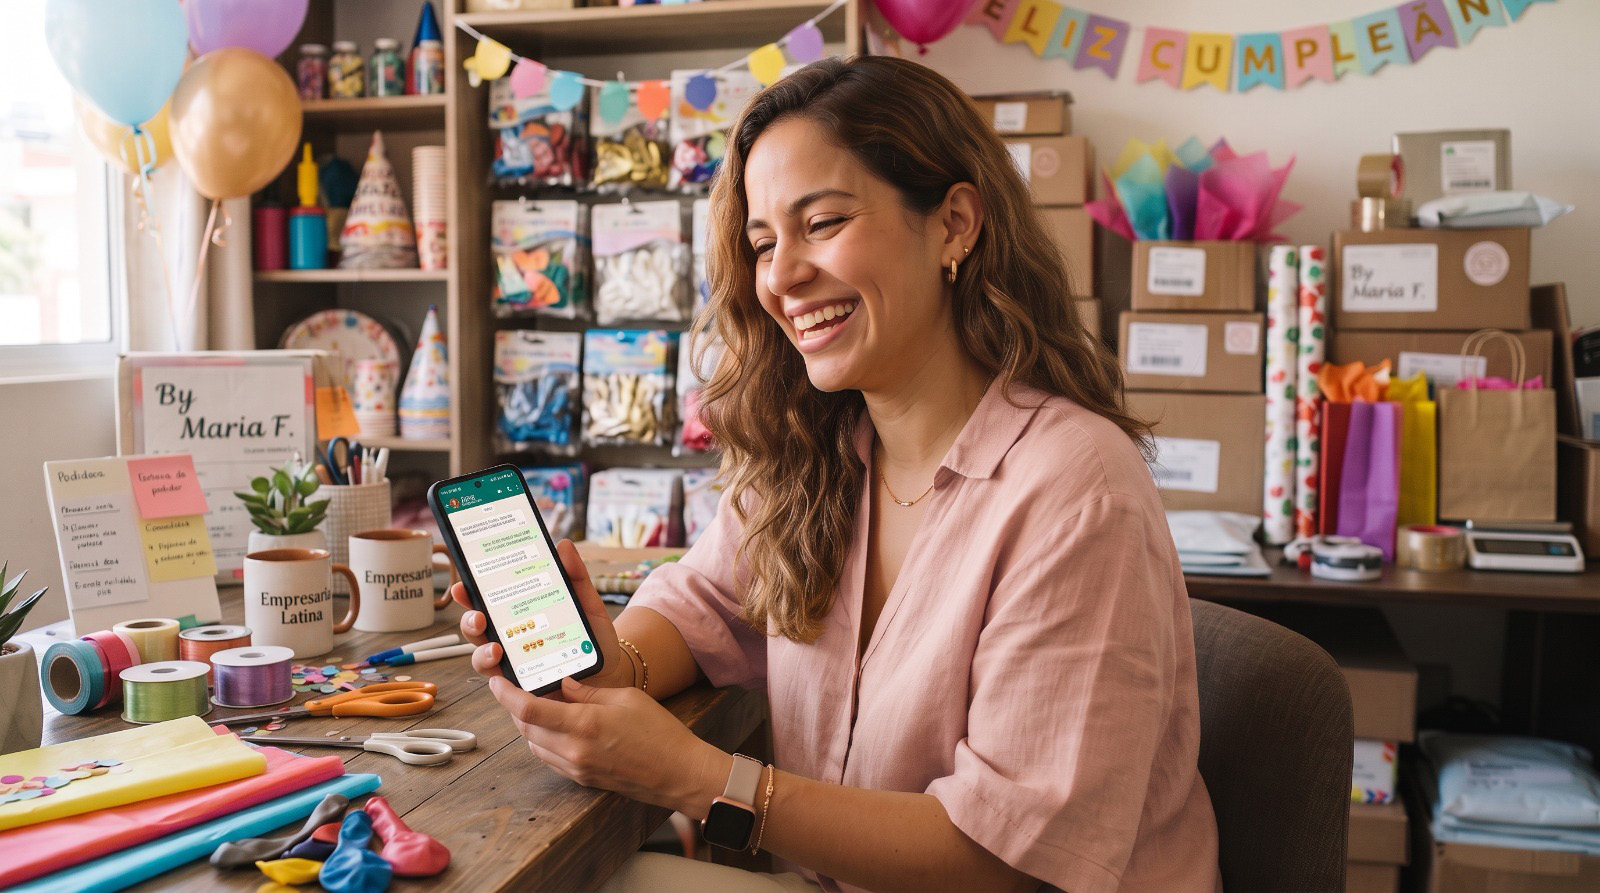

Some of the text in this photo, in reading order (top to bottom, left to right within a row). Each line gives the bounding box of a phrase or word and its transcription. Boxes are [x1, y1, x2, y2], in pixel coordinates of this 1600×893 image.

[982, 0, 1118, 60] ELIZ
[1351, 264, 1374, 281] By
[1351, 283, 1405, 300] Maria
[155, 382, 197, 414] By
[180, 414, 294, 439] Maria F.
[365, 565, 432, 587] Empresaria
[261, 587, 331, 609] Empresaria
[384, 586, 423, 601] Latina
[281, 609, 323, 625] Latina
